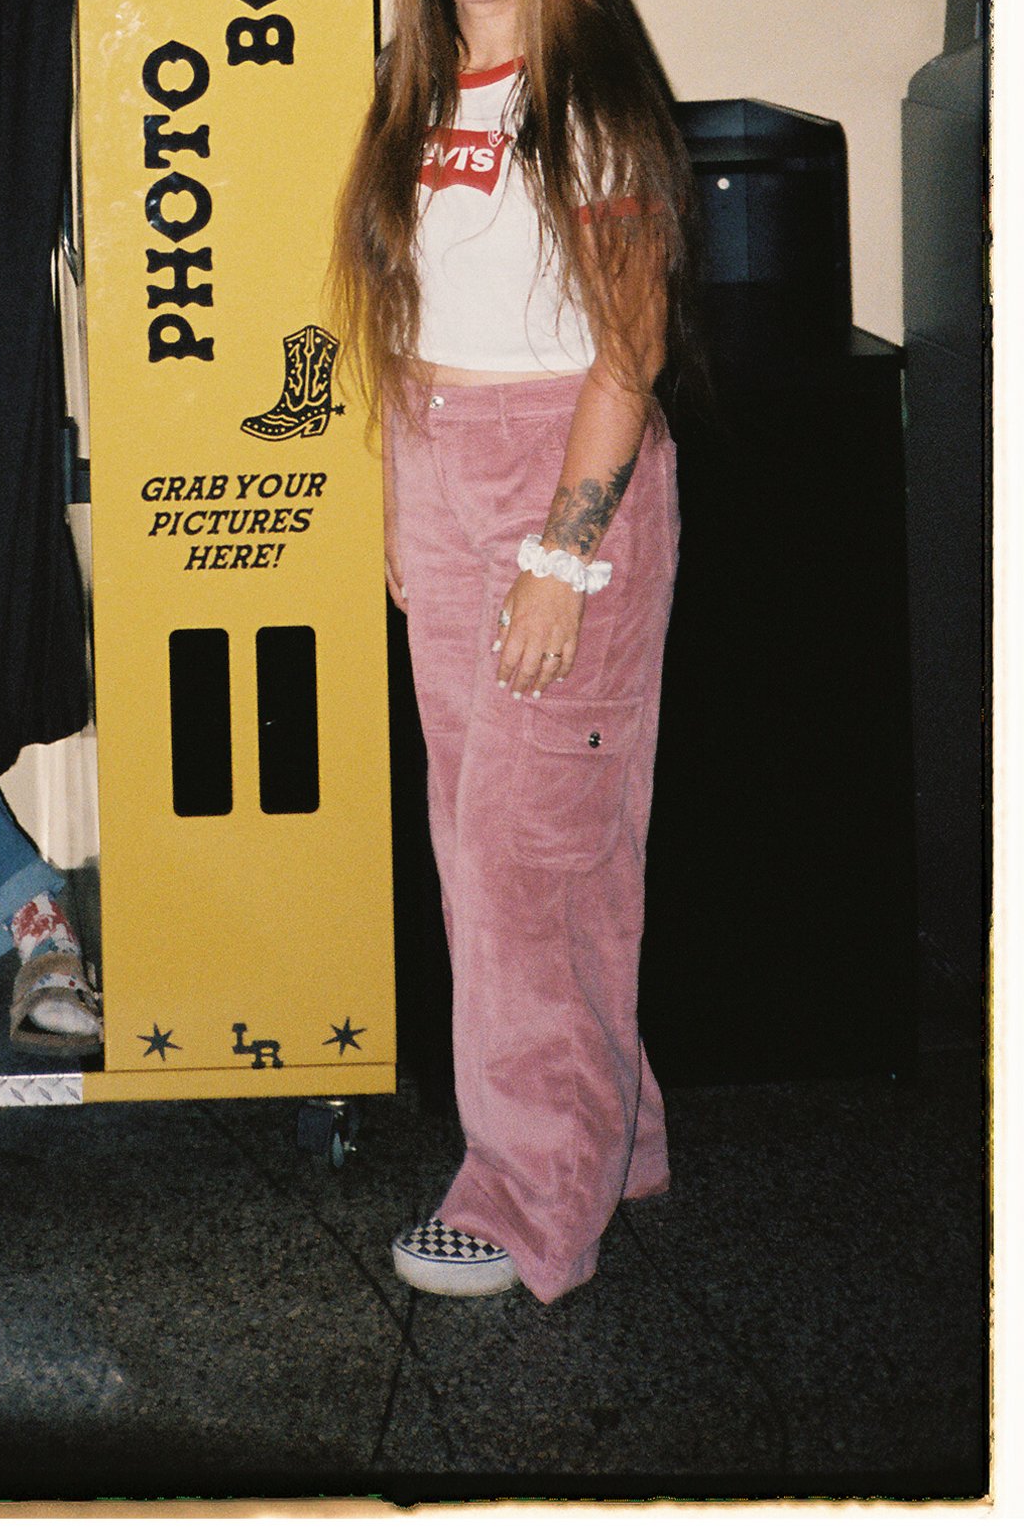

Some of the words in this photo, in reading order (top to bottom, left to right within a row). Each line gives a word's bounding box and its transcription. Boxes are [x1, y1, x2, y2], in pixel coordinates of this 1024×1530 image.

[142, 39, 214, 362] PHOTO
[141, 474, 228, 501] GRAB
[236, 472, 326, 499] YOUR
[148, 508, 313, 536] PICTURES
[184, 543, 285, 570] HERE!
[231, 1022, 284, 1069] LR
